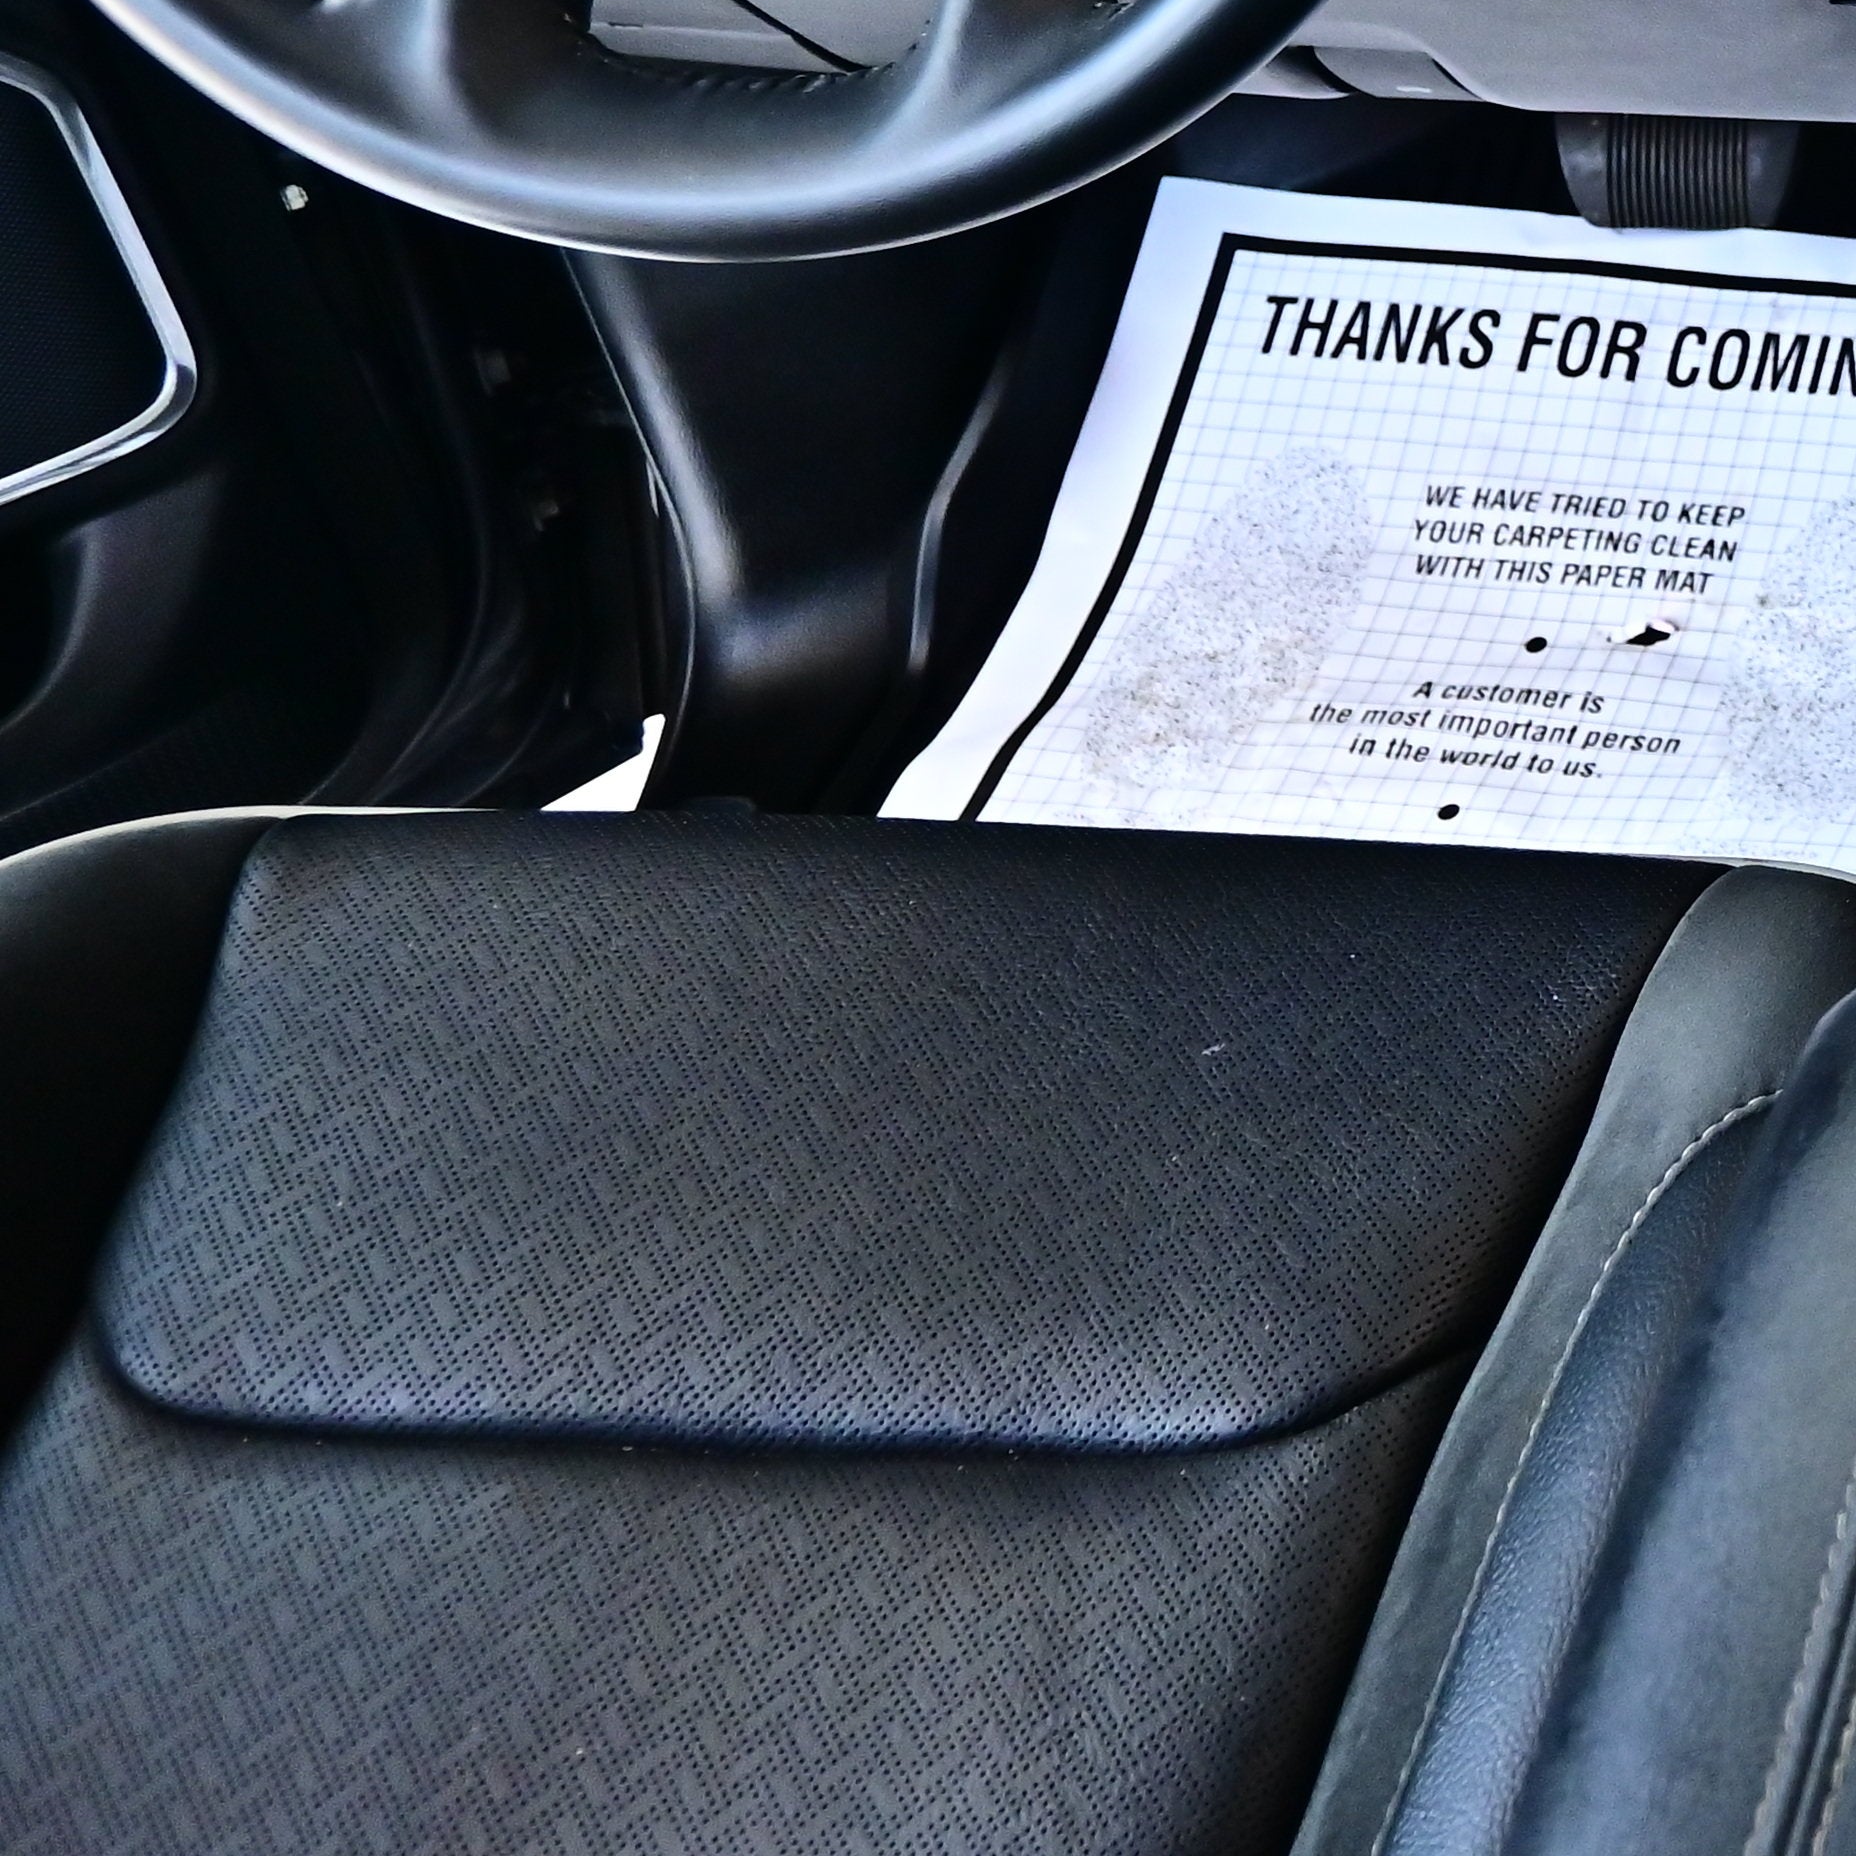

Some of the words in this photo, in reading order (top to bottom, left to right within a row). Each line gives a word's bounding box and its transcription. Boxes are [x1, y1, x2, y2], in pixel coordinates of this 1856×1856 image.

[1261, 295, 1501, 369] THANKS
[1516, 311, 1648, 382] FOR
[1425, 485, 1466, 508] WE
[1472, 487, 1543, 513] HAVE
[1550, 493, 1628, 519] TRIED
[1637, 499, 1670, 523] TO
[1676, 502, 1746, 528] KEEP
[1413, 519, 1485, 545] YOUR
[1492, 523, 1643, 555] CARPETING
[1650, 534, 1738, 562] CLEAN
[1414, 554, 1486, 580] WITH
[1493, 558, 1553, 585] THIS
[1560, 562, 1647, 589] PAPER
[1654, 568, 1715, 595] MAT
[1412, 681, 1434, 699] A
[1440, 683, 1573, 710] customer
[1579, 690, 1606, 715] is
[1309, 703, 1353, 725] the
[1360, 708, 1432, 729] most
[1437, 710, 1579, 745] important
[1581, 730, 1682, 755] person
[1348, 732, 1377, 756] in
[1385, 737, 1431, 763] the
[1439, 746, 1521, 772] world
[1527, 752, 1555, 775] to
[1562, 758, 1603, 779] us.
